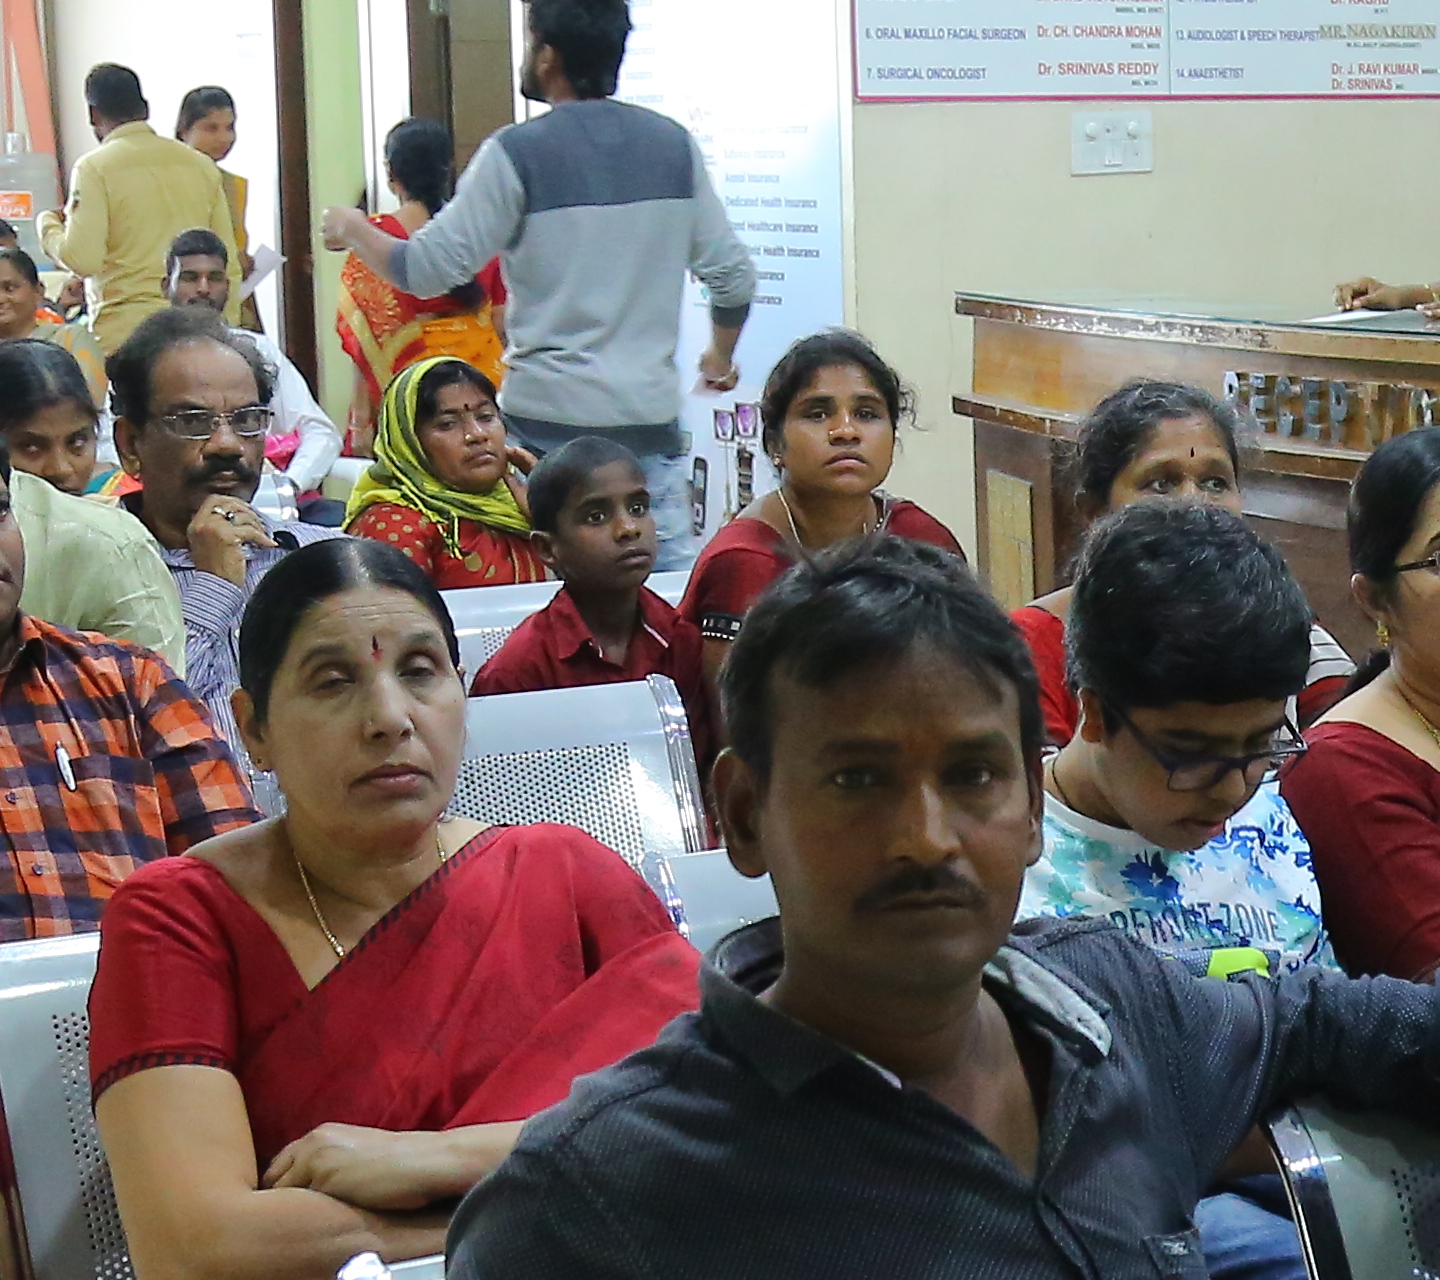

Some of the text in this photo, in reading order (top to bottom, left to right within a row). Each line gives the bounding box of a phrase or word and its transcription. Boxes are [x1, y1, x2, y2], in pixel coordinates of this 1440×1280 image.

[875, 28, 901, 40] ORAL
[904, 28, 945, 40] MAXILLO
[947, 28, 980, 40] FACIAL
[981, 28, 1027, 41] SURGEON
[1037, 25, 1162, 38] Dr. CH. CHANDRA MOHAN
[1187, 30, 1239, 41] AUDIOLOGIST
[1247, 30, 1276, 41] SPEECH
[1279, 30, 1320, 41] THERAPIST
[876, 68, 925, 79] SURGICAL
[927, 68, 986, 80] ONCOLOGIST
[1038, 63, 1159, 75] Dr. SRINIVAS REDDY
[1188, 69, 1244, 79] ANAESTHETIST
[1332, 64, 1345, 75] Dr.
[1358, 64, 1381, 75] RAVI
[1383, 64, 1419, 75] KUMAR
[1332, 79, 1393, 90] Dr. SRINIVAS
